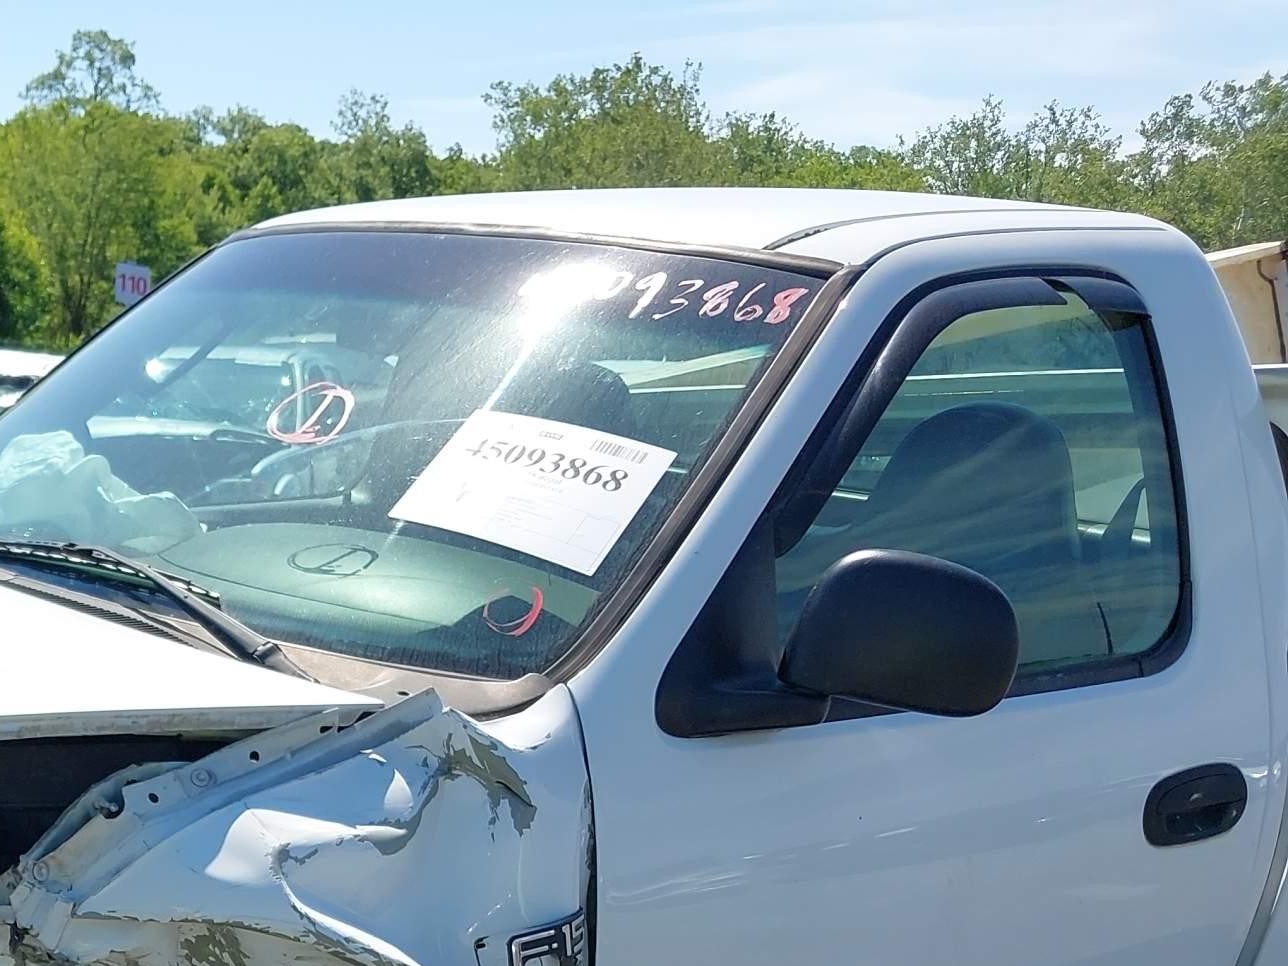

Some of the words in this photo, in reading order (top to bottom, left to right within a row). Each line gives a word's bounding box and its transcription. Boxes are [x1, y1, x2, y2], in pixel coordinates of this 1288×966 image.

[119, 273, 148, 297] 110
[594, 270, 809, 324] 093868
[465, 438, 629, 492] 45093868
